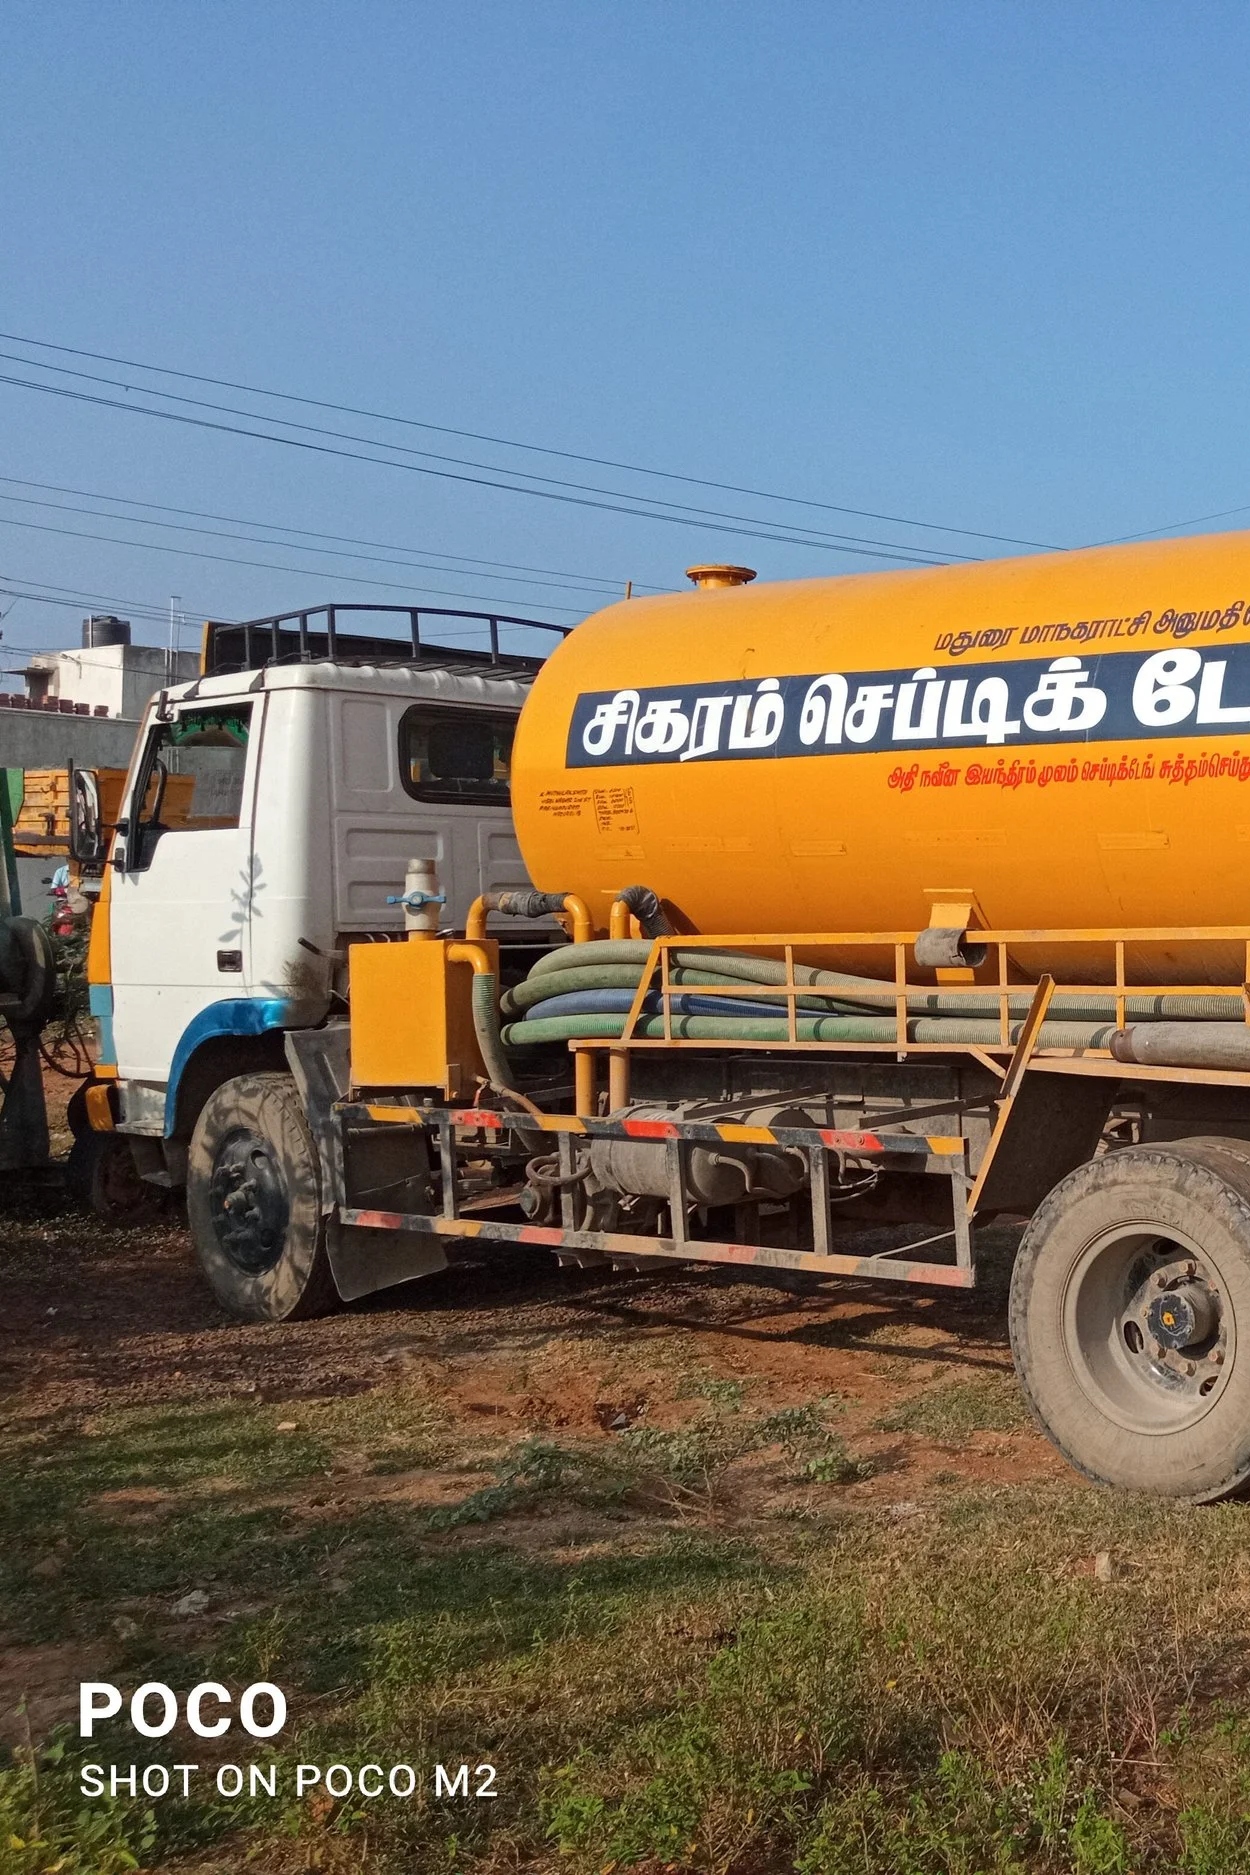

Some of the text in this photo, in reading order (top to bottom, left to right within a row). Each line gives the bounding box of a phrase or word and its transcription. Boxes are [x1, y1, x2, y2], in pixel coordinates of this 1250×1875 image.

[933, 626, 1020, 657] மதுரை
[1019, 610, 1153, 645] மாநகராட்சி
[582, 677, 786, 762] சிகரம்
[799, 656, 1108, 745] செப்டிக்
